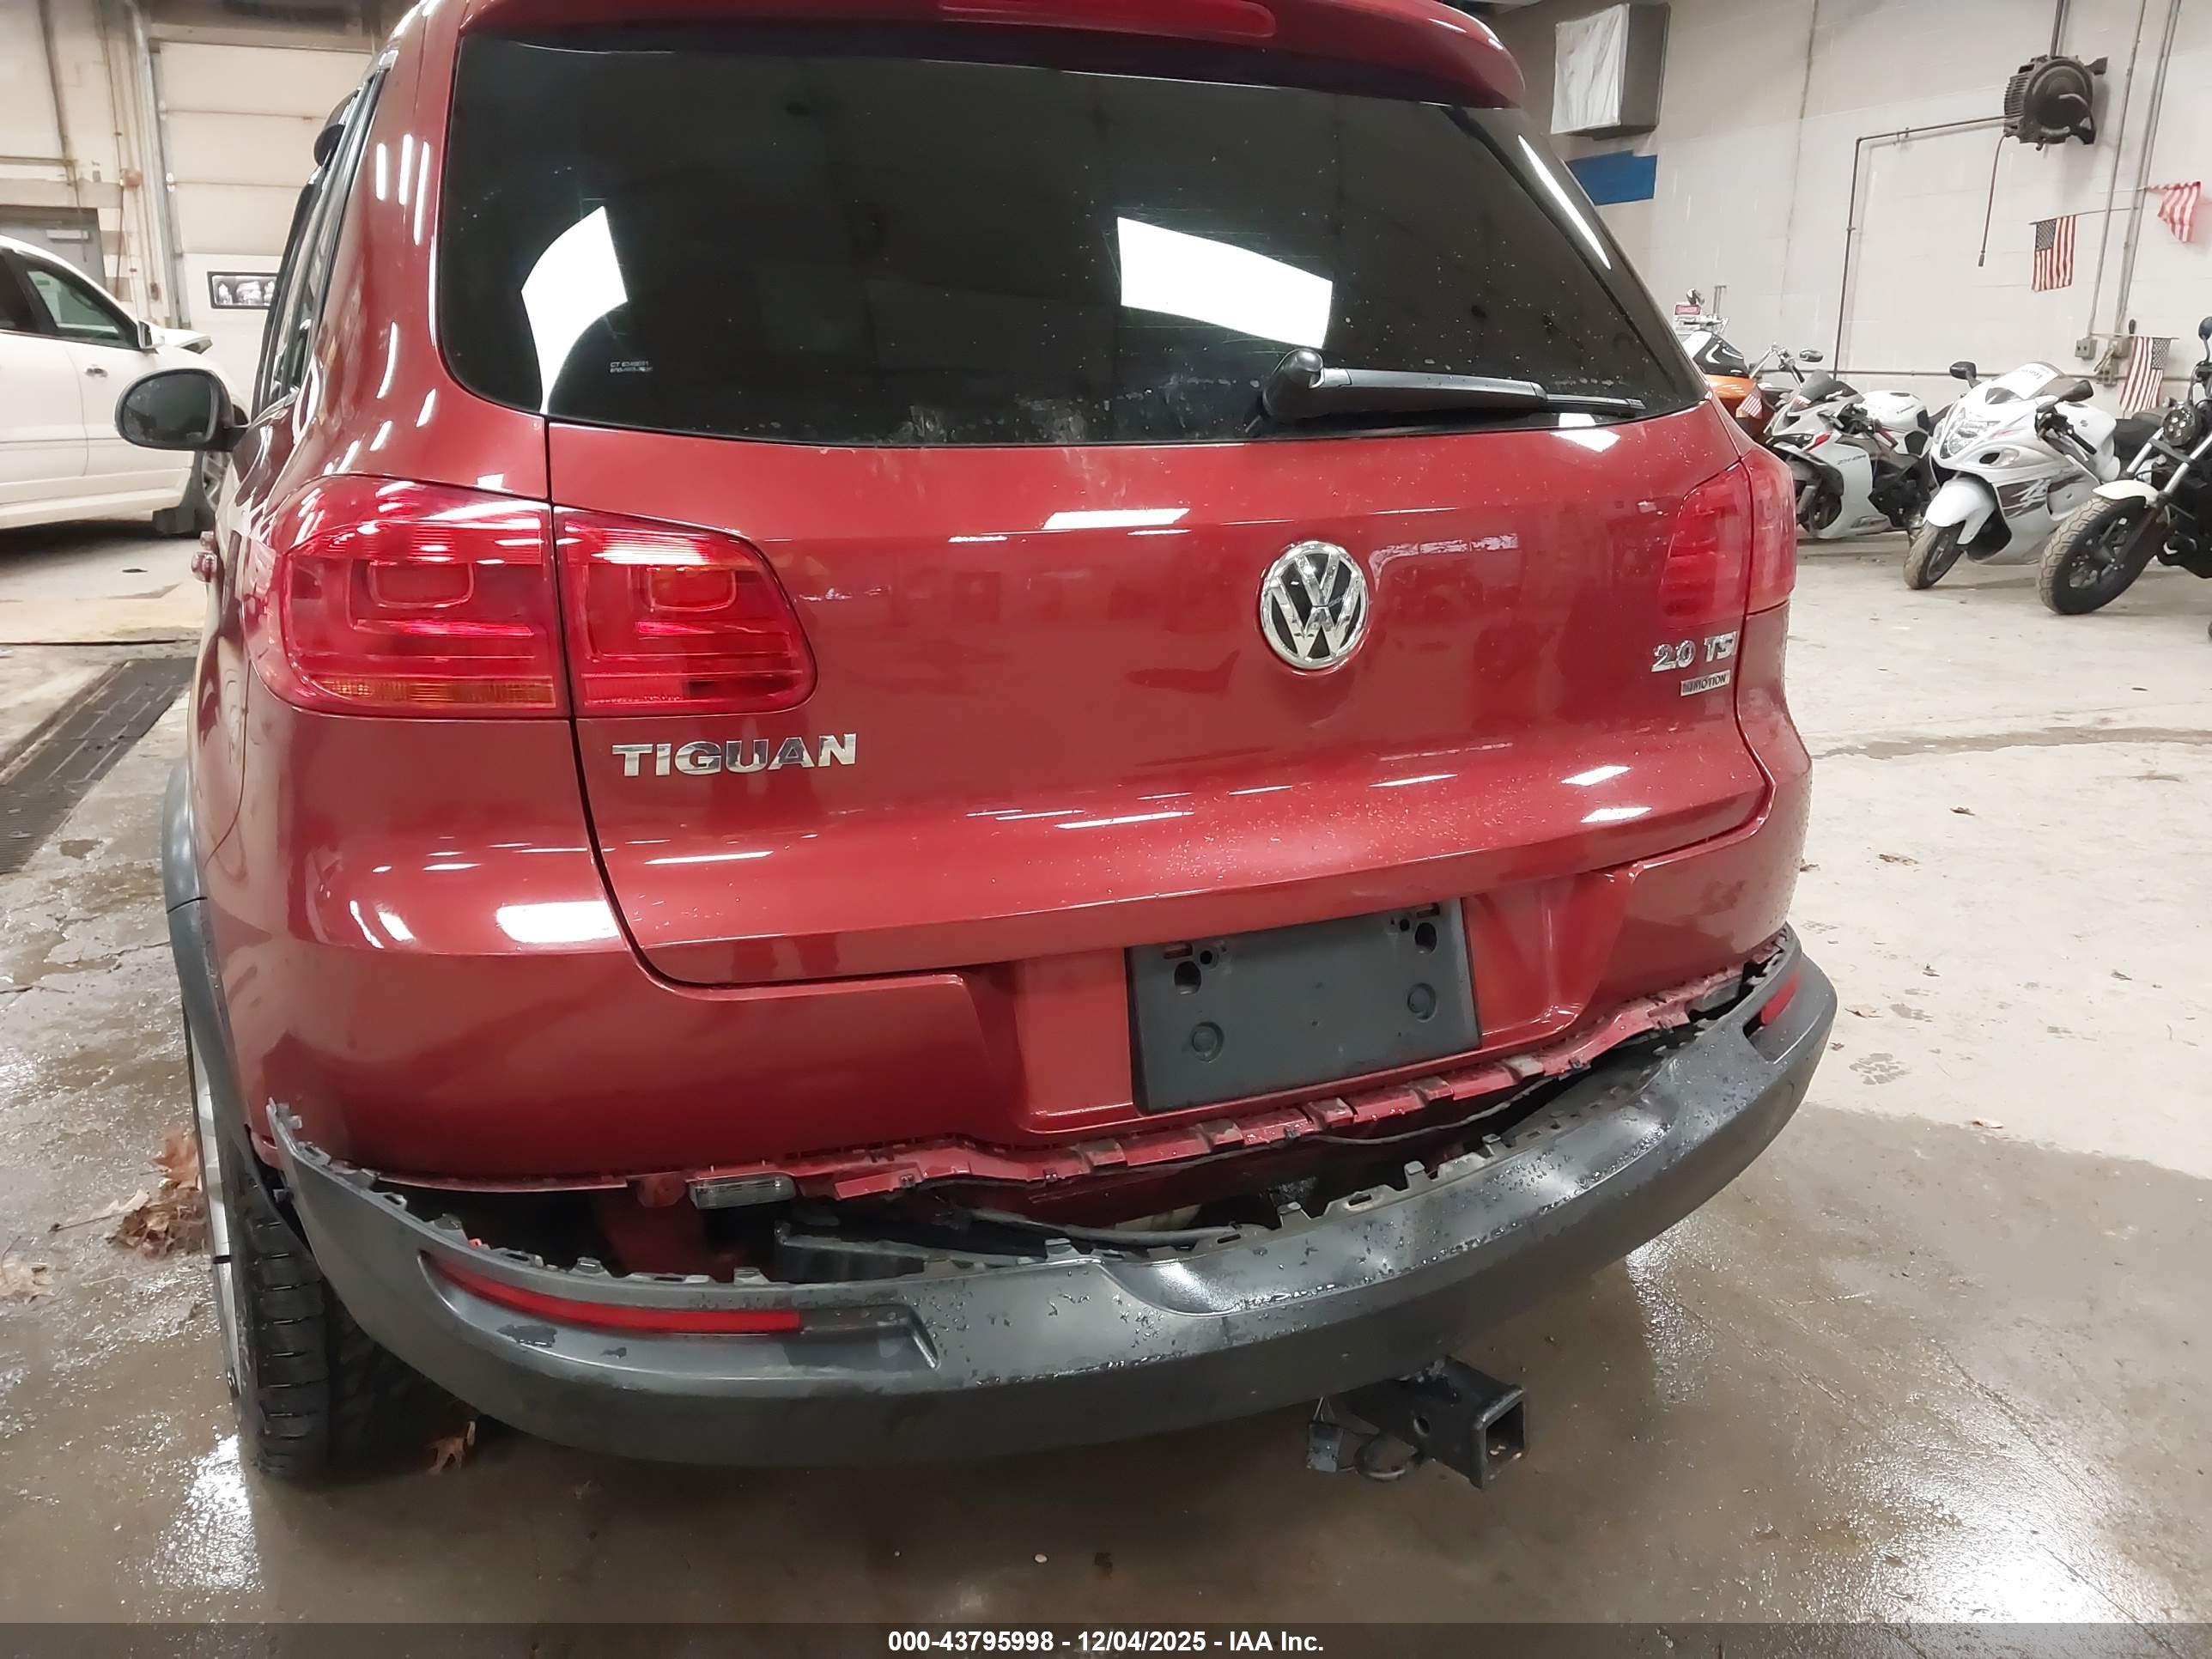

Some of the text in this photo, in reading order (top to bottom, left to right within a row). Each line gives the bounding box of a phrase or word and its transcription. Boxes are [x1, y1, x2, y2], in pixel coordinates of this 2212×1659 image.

[1266, 546, 1365, 663] VW
[1650, 631, 1739, 672] 2.0 TSI
[611, 732, 857, 777] TIGUAN
